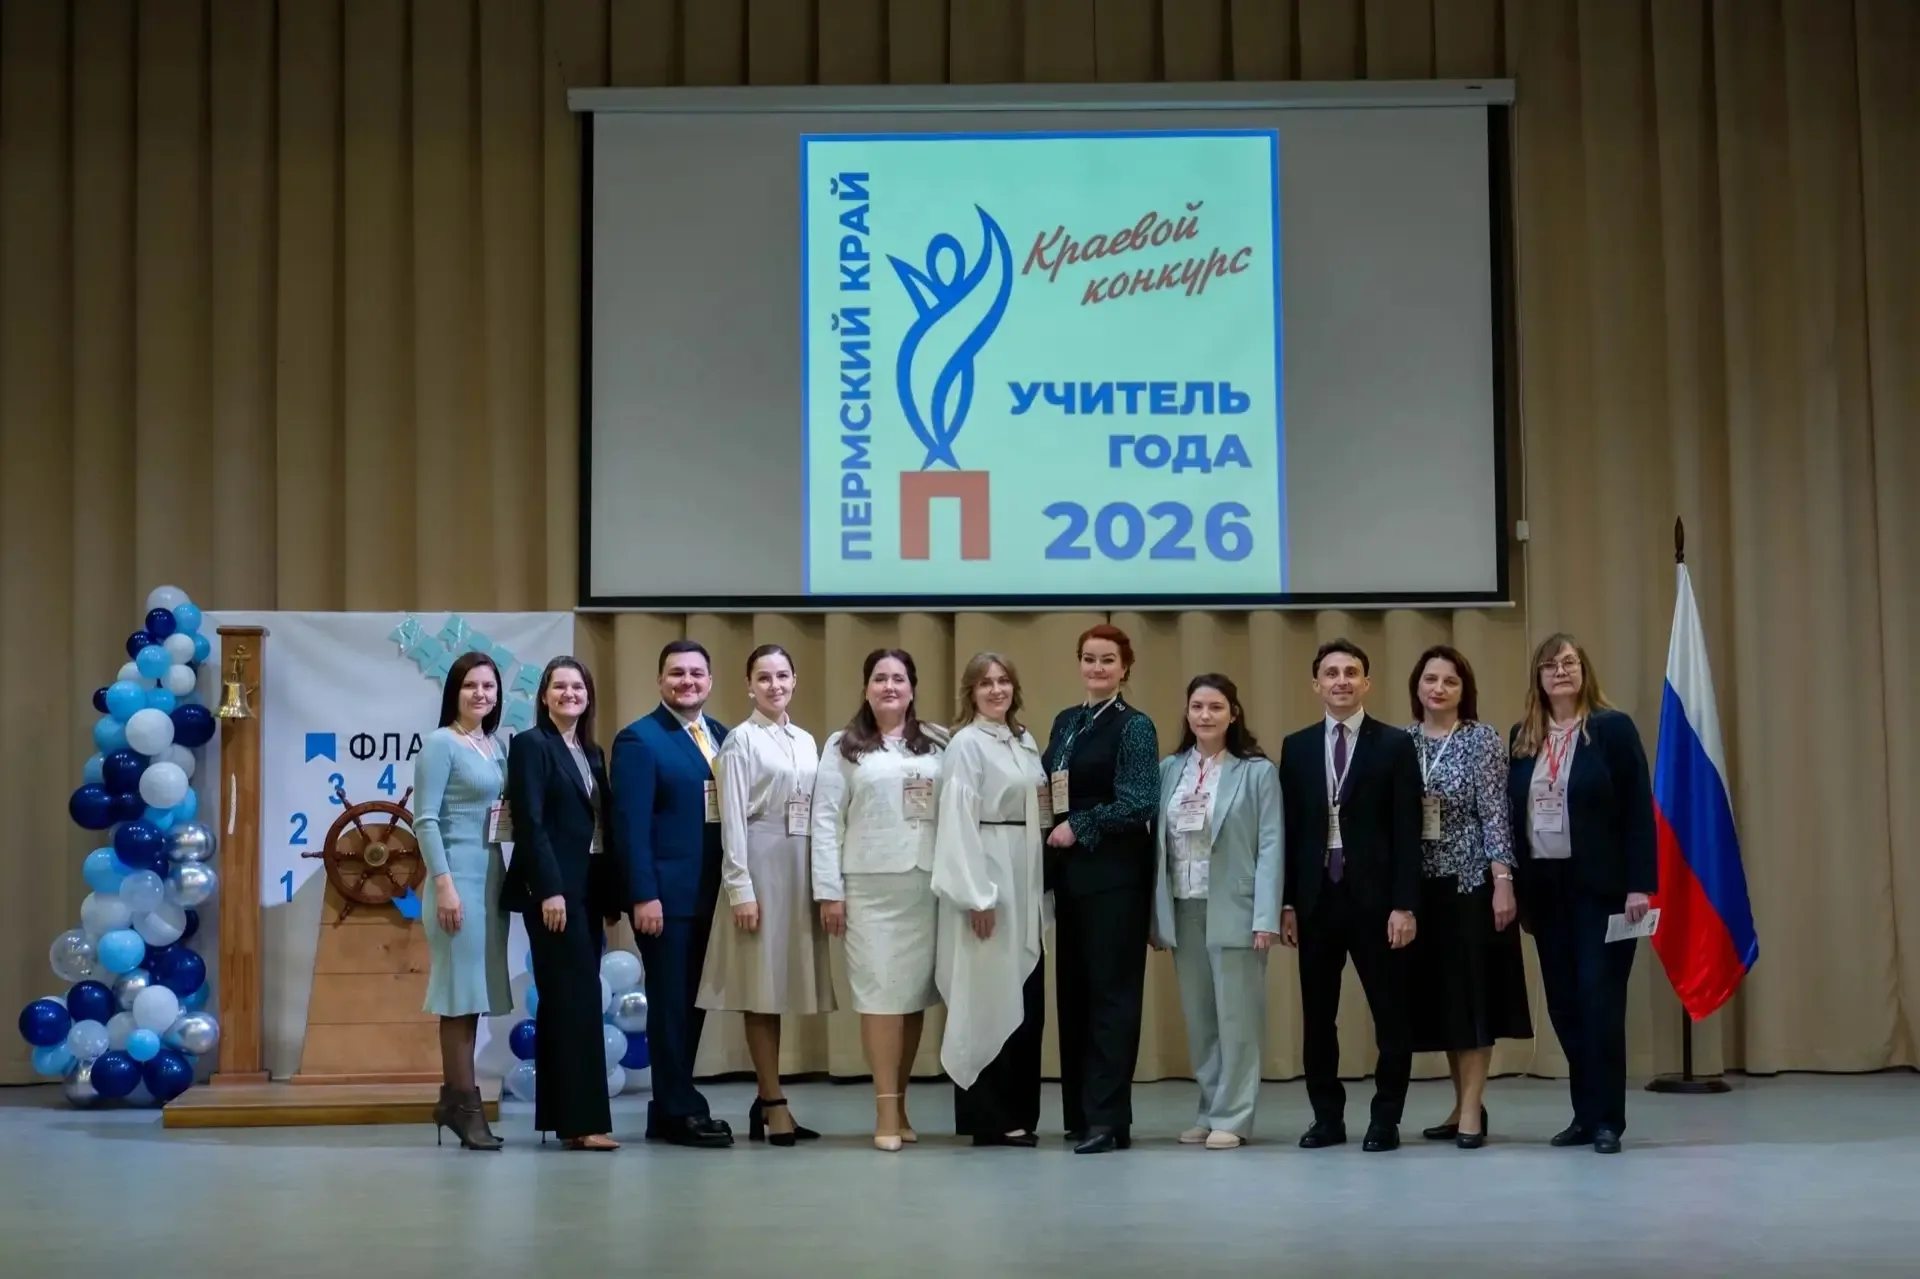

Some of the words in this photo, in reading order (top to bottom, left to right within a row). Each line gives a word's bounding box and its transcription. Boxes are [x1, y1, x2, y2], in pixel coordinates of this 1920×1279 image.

[830, 172, 870, 290] КРАЙ
[1021, 200, 1204, 283] Краевой
[1080, 247, 1252, 306] конкурс
[1008, 381, 1251, 415] УЧИТЕЛЬ
[831, 307, 872, 560] ПЕРМСКИЙ
[1108, 434, 1253, 473] ГОДА
[900, 470, 990, 560] П
[1041, 501, 1254, 562] 2026
[349, 732, 424, 761] ФЛА
[328, 772, 345, 804] 3
[377, 764, 396, 795] 4
[289, 812, 308, 845] 2
[280, 870, 293, 902] 1
